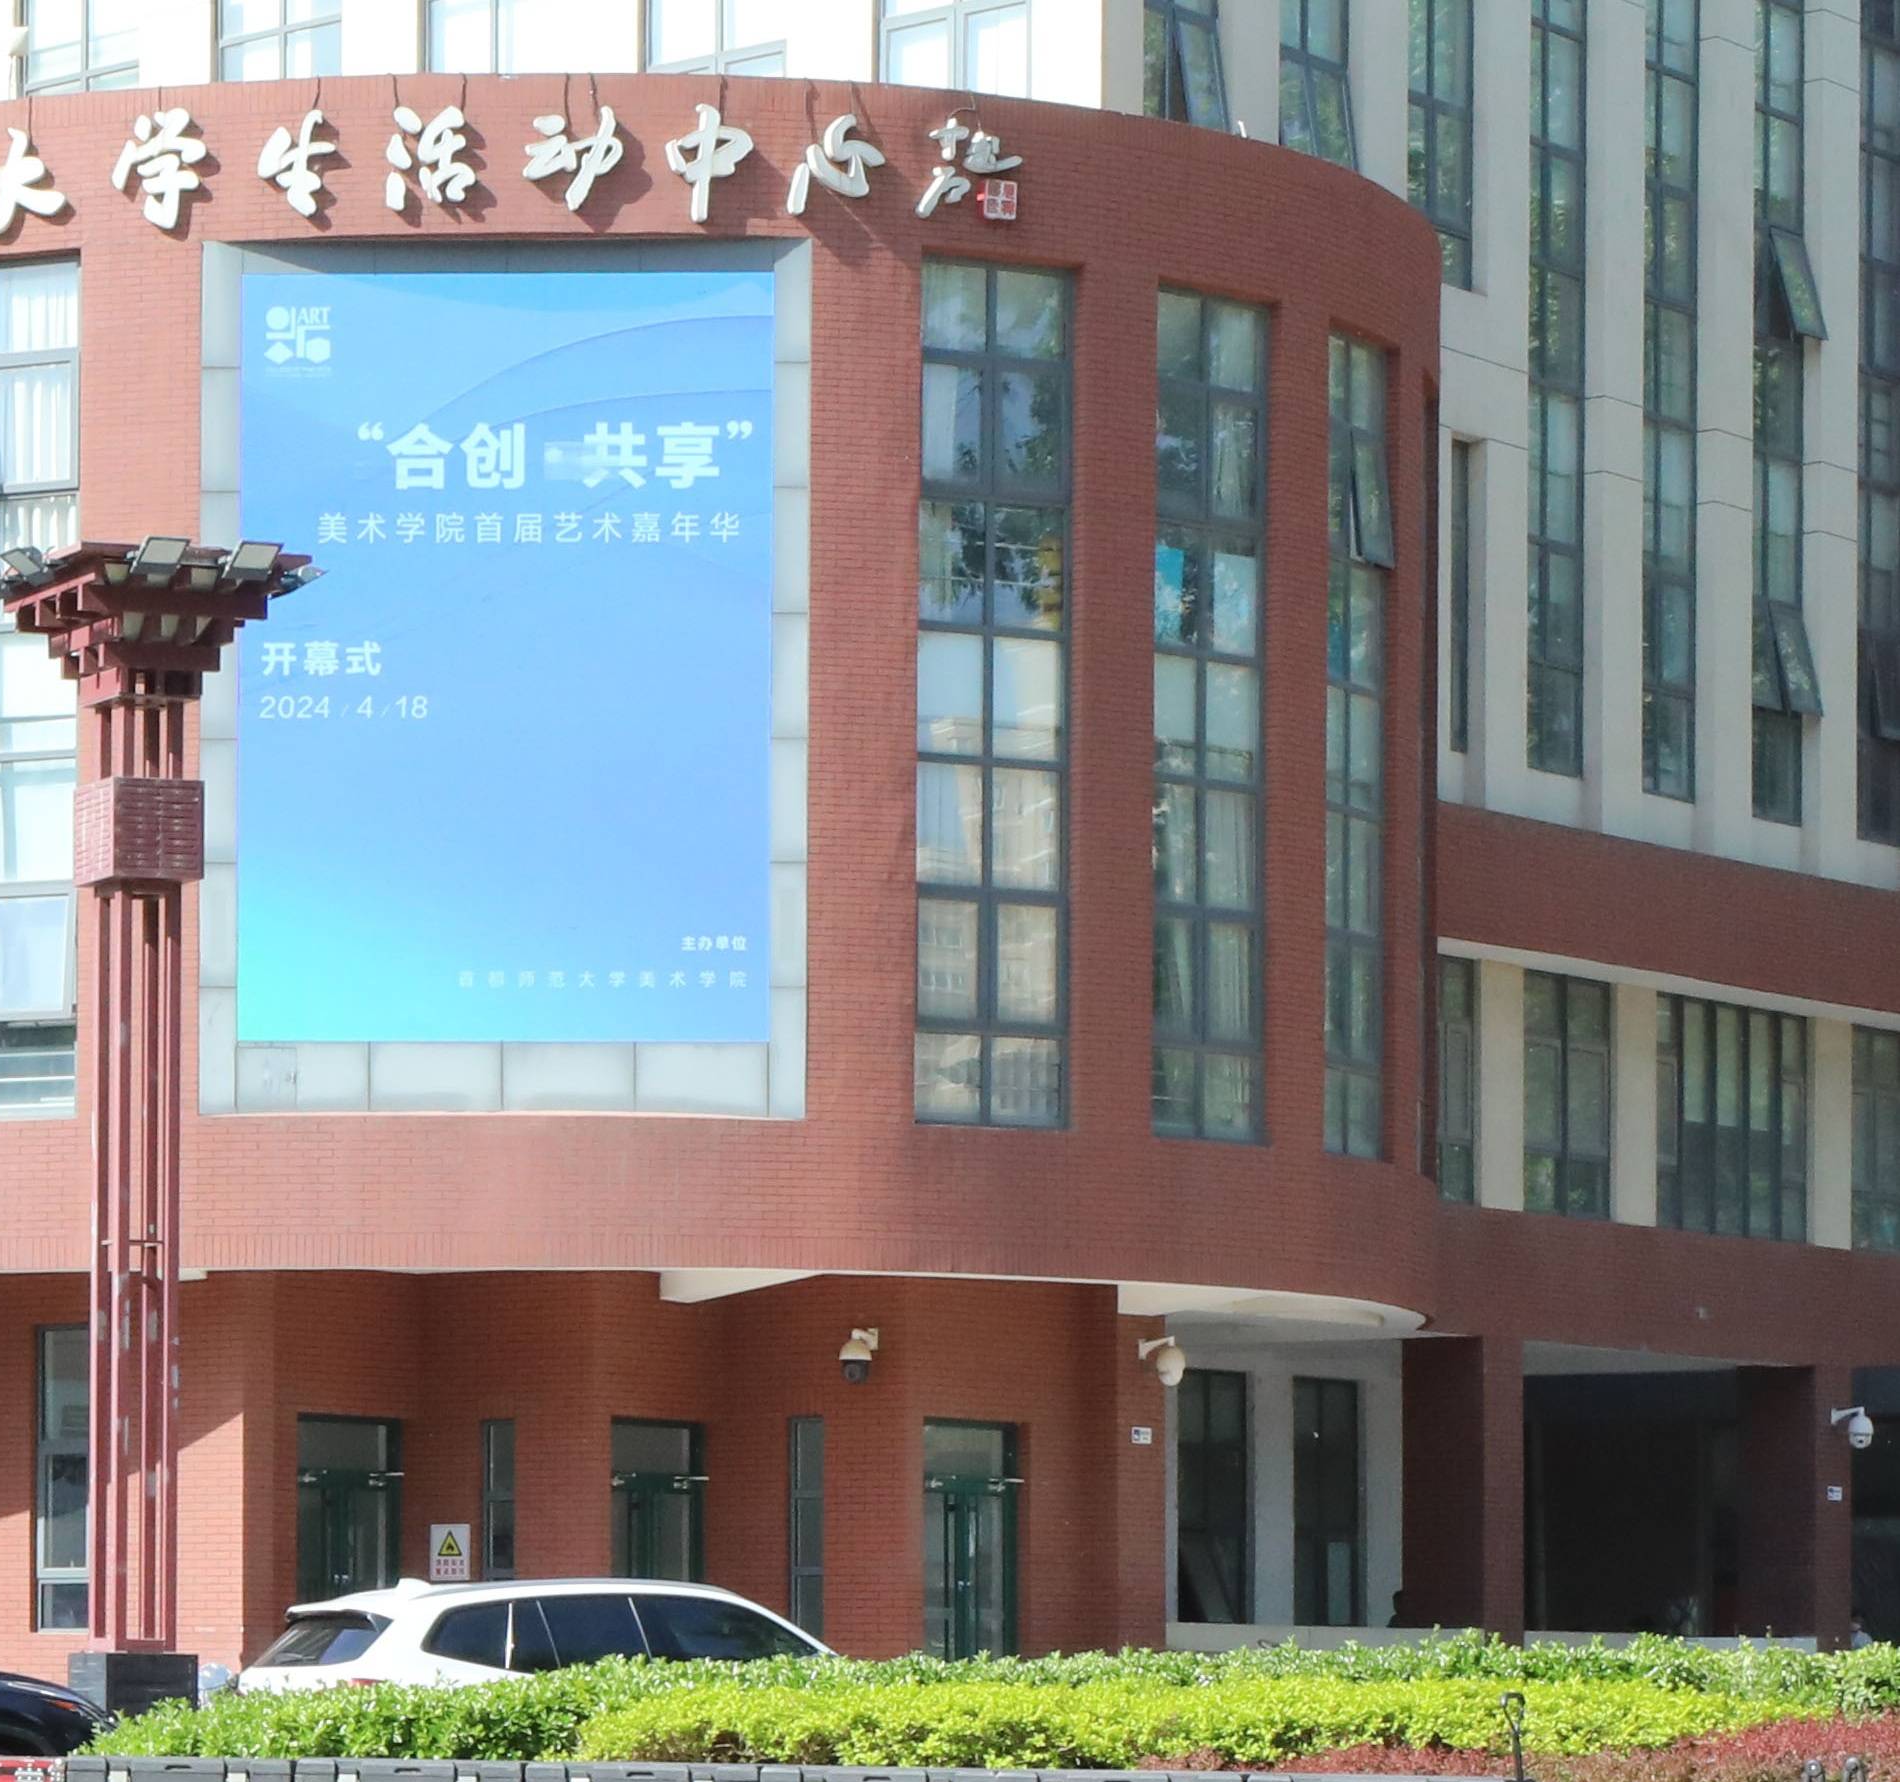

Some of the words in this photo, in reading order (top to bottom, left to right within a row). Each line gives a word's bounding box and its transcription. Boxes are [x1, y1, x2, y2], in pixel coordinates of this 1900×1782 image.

[296, 305, 331, 324] ART
[317, 511, 741, 545] 美术学院首届艺术嘉年华
[260, 640, 382, 677] 开幕式
[681, 934, 748, 951] 主办单位
